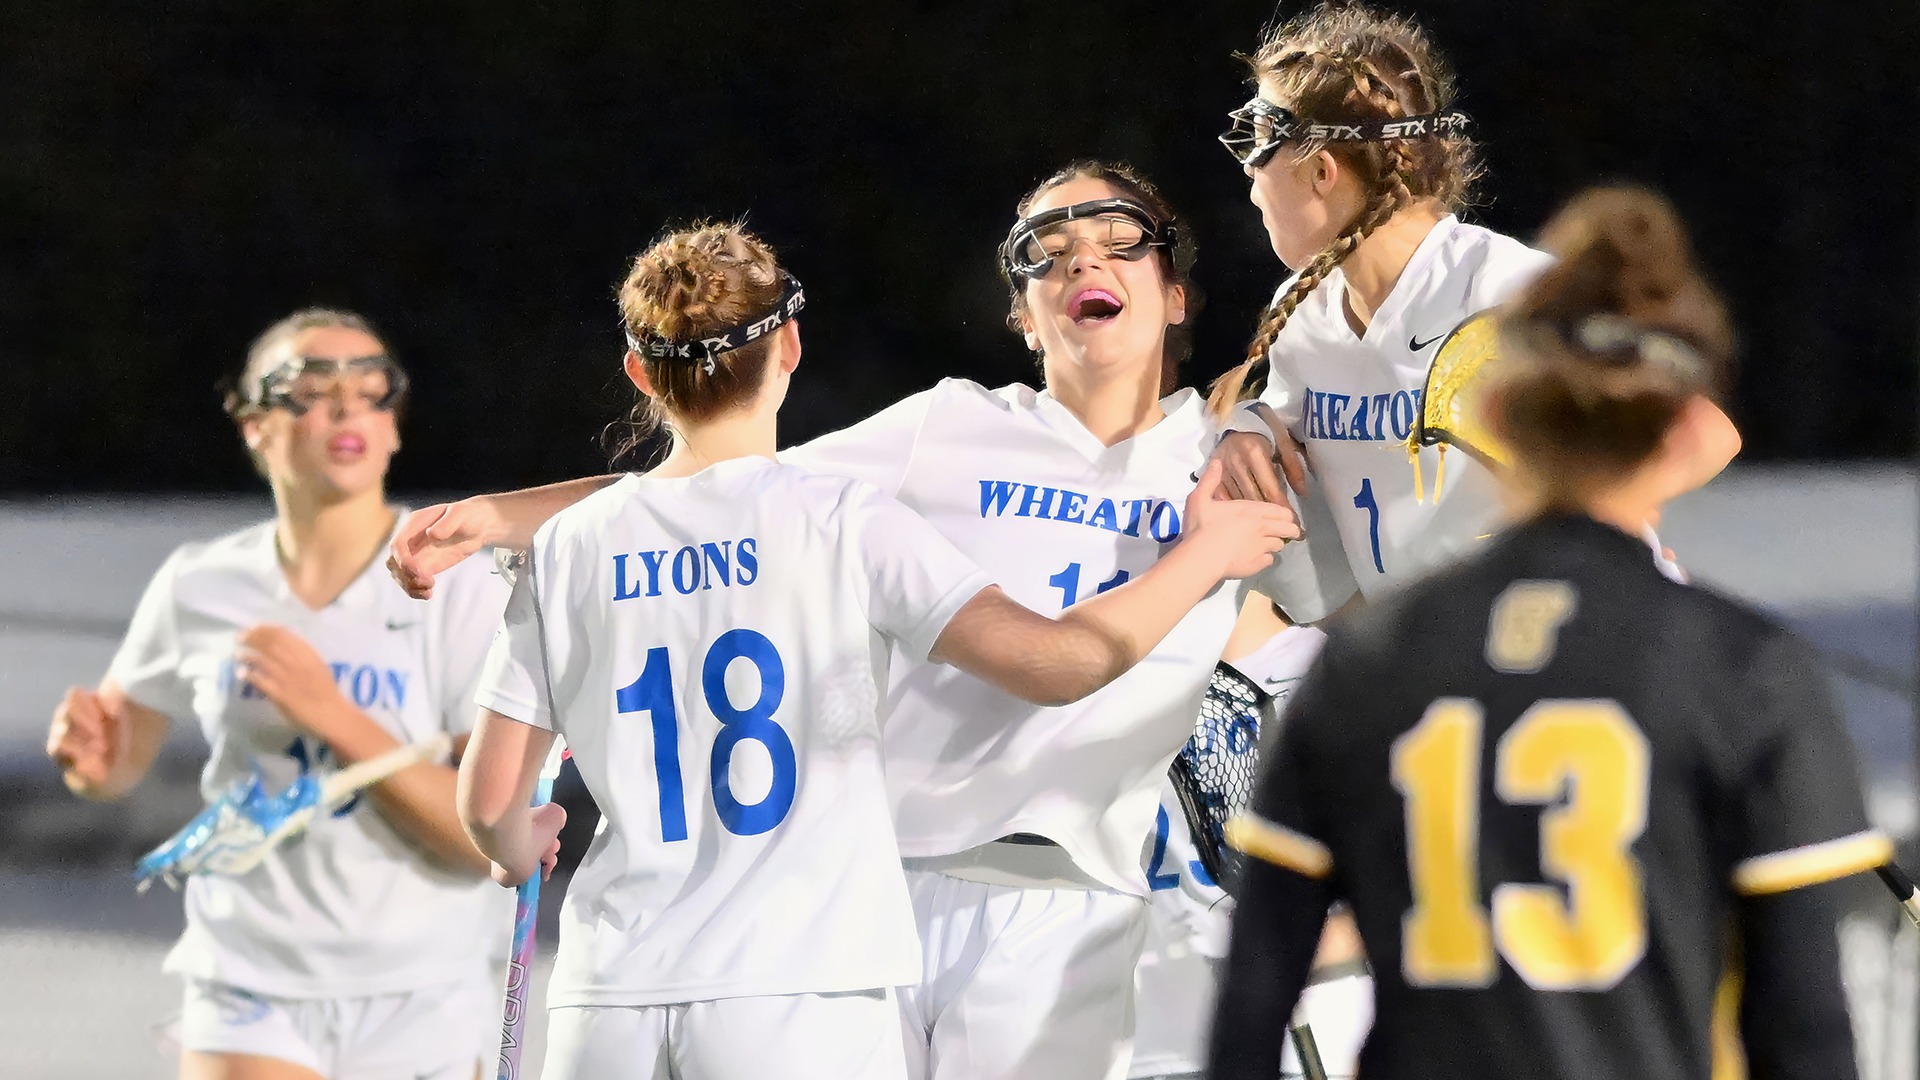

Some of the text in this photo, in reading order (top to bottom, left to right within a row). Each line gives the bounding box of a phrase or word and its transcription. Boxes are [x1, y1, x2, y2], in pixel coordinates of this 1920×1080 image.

[1309, 123, 1364, 140] STX
[1381, 119, 1427, 139] STX
[746, 310, 783, 341] STX
[978, 479, 1184, 543] WHEATO
[1353, 477, 1386, 574] 1
[612, 536, 759, 602] LYONS
[615, 627, 798, 844] 18
[1389, 697, 1652, 992] 13
